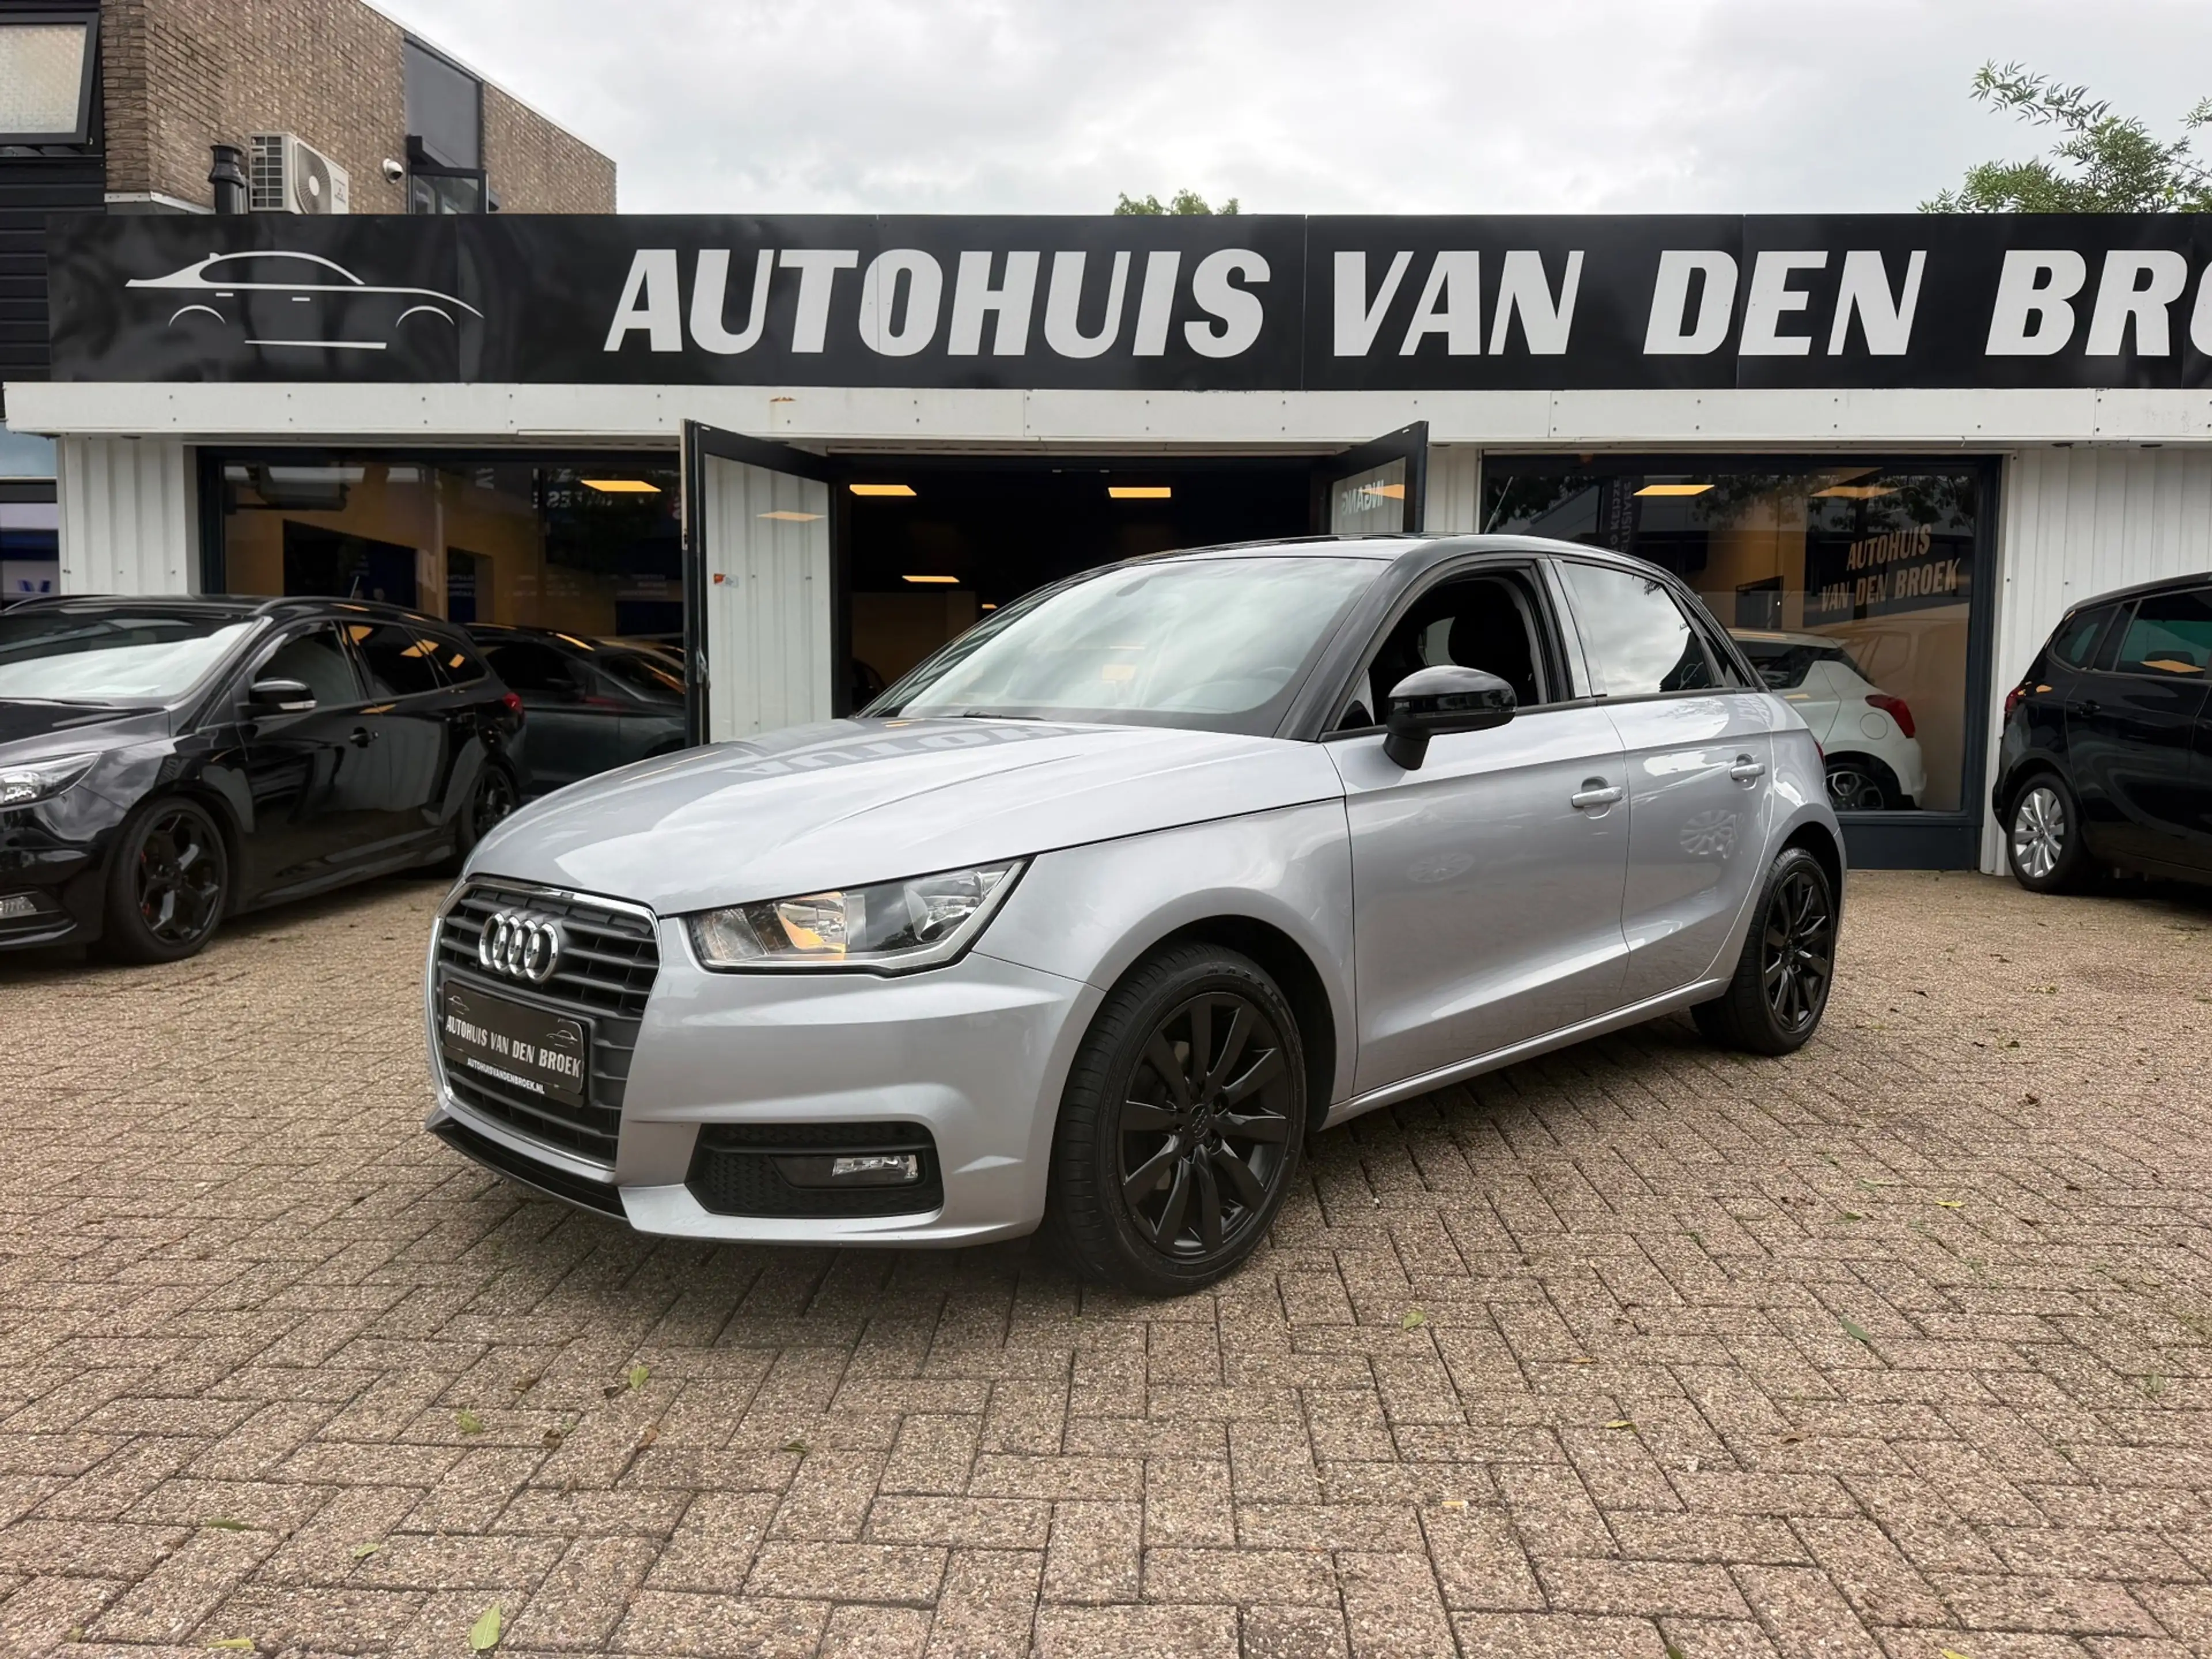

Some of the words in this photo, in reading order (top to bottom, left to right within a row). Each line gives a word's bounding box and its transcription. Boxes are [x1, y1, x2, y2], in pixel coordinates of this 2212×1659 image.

[604, 248, 1271, 358] AUTOHUIS
[1334, 251, 1585, 357] VAN
[1643, 250, 1927, 356] DEN
[1985, 250, 2212, 357] BR
[1846, 523, 1932, 571] AUTOHUIS
[1821, 581, 1850, 612] VAN
[1855, 573, 1888, 606] DEN
[1894, 557, 1961, 600] BROEK
[446, 1015, 488, 1047] AUTOHUIS
[490, 1032, 510, 1055] VAN
[512, 1040, 536, 1063] DEN
[538, 1048, 582, 1078] BROEK
[467, 1057, 545, 1094] AUTOHUISVANDENBROEK.NL
